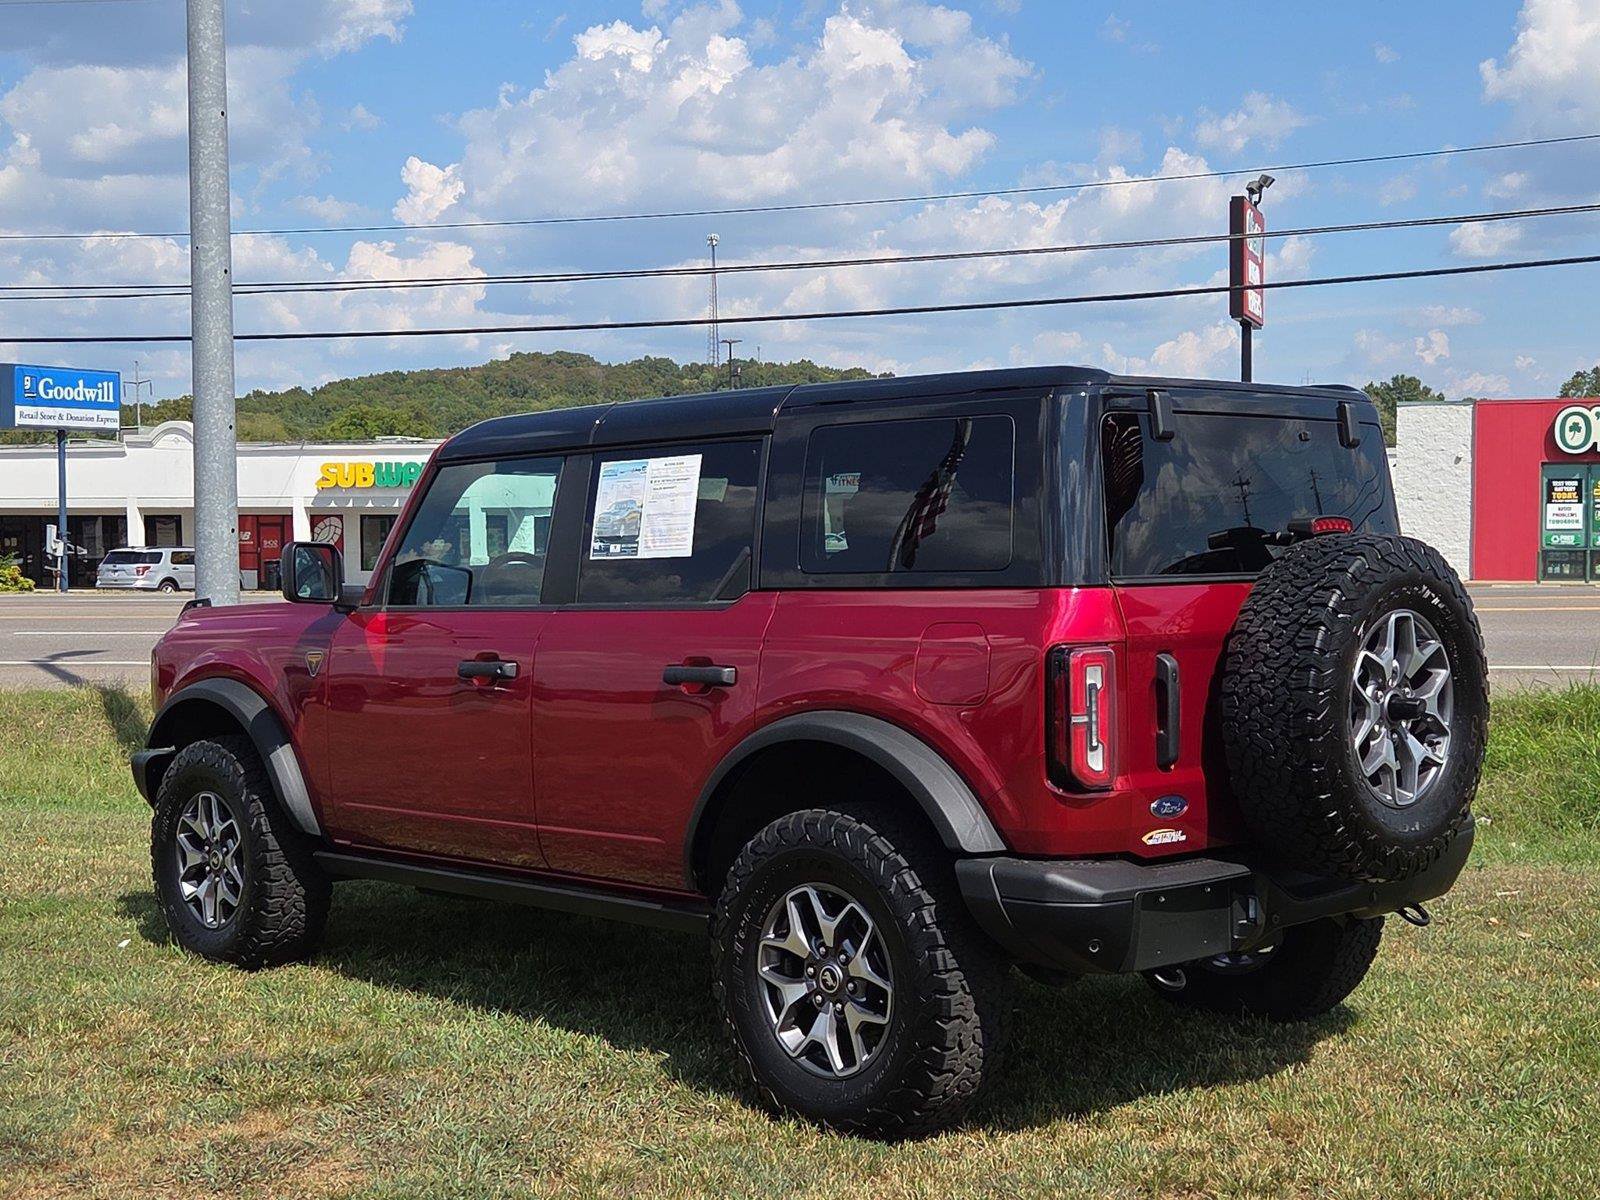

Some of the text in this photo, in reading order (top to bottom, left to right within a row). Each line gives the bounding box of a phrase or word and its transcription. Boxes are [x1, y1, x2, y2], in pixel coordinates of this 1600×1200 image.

[38, 377, 114, 403] Goodwill
[19, 410, 119, 426] Retail Store & Donation Express
[315, 461, 427, 490] SUBWA
[1160, 801, 1182, 814] Ford
